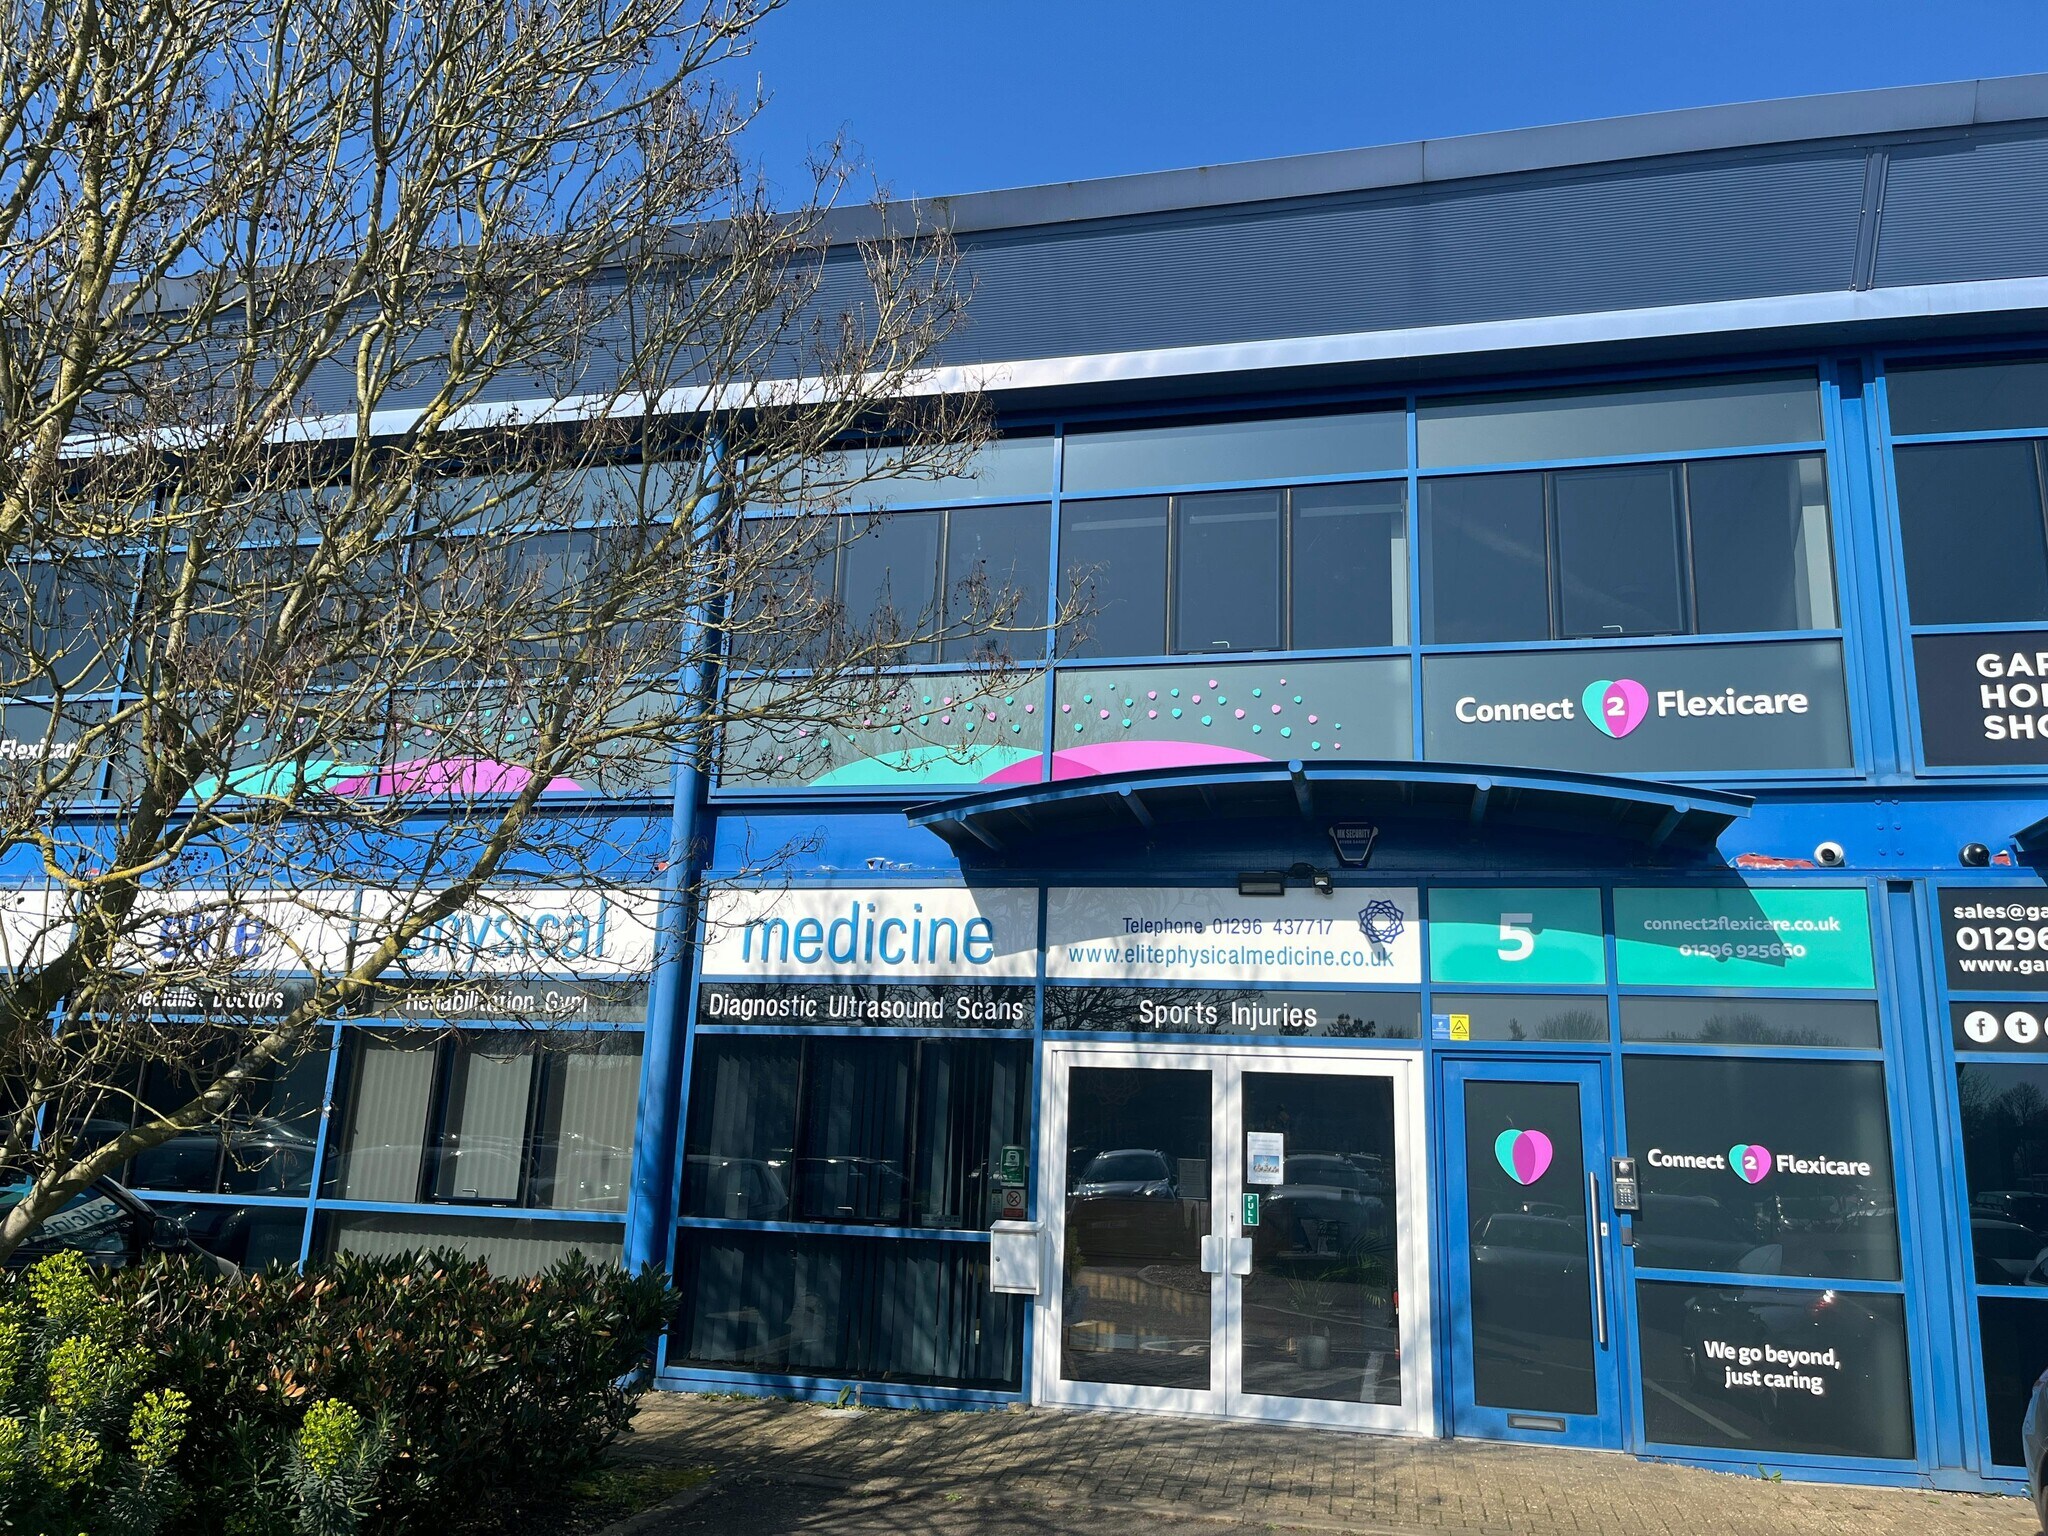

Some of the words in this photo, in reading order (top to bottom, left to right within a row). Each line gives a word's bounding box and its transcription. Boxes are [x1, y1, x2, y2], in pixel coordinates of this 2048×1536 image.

[1455, 697, 1575, 723] Connect
[1606, 696, 1626, 717] 2
[1657, 688, 1808, 717] Flexicare
[1, 738, 77, 760] Flexicar
[1346, 829, 1370, 838] SECURITY
[742, 900, 995, 964] medicine
[1122, 917, 1203, 938] Telephone
[1213, 918, 1263, 935] 01296
[1272, 919, 1334, 936] 437717
[1643, 916, 1841, 931] connect2flexicare.co.uk
[1497, 913, 1535, 962] 5
[1068, 945, 1395, 968] www.elitephysicalmedicine.co.uk
[1679, 943, 1732, 958] 01296
[1736, 943, 1806, 959] 925660
[1959, 959, 2048, 975] www.ga
[545, 991, 588, 1016] Gym
[709, 993, 817, 1020] Diagnostic
[829, 993, 944, 1019] Ultrasound
[956, 996, 1024, 1020] Scans
[1139, 1000, 1218, 1027] Sports
[1231, 1001, 1317, 1031] Injuries
[1647, 1149, 1725, 1170] Connect
[1744, 1156, 1757, 1170] 2
[1776, 1154, 1871, 1176] Flexicare
[1704, 1341, 1735, 1359] We
[1738, 1347, 1762, 1366] go
[1764, 1344, 1841, 1370] beyond,
[1724, 1366, 1761, 1389] just
[1763, 1370, 1824, 1395] caring
